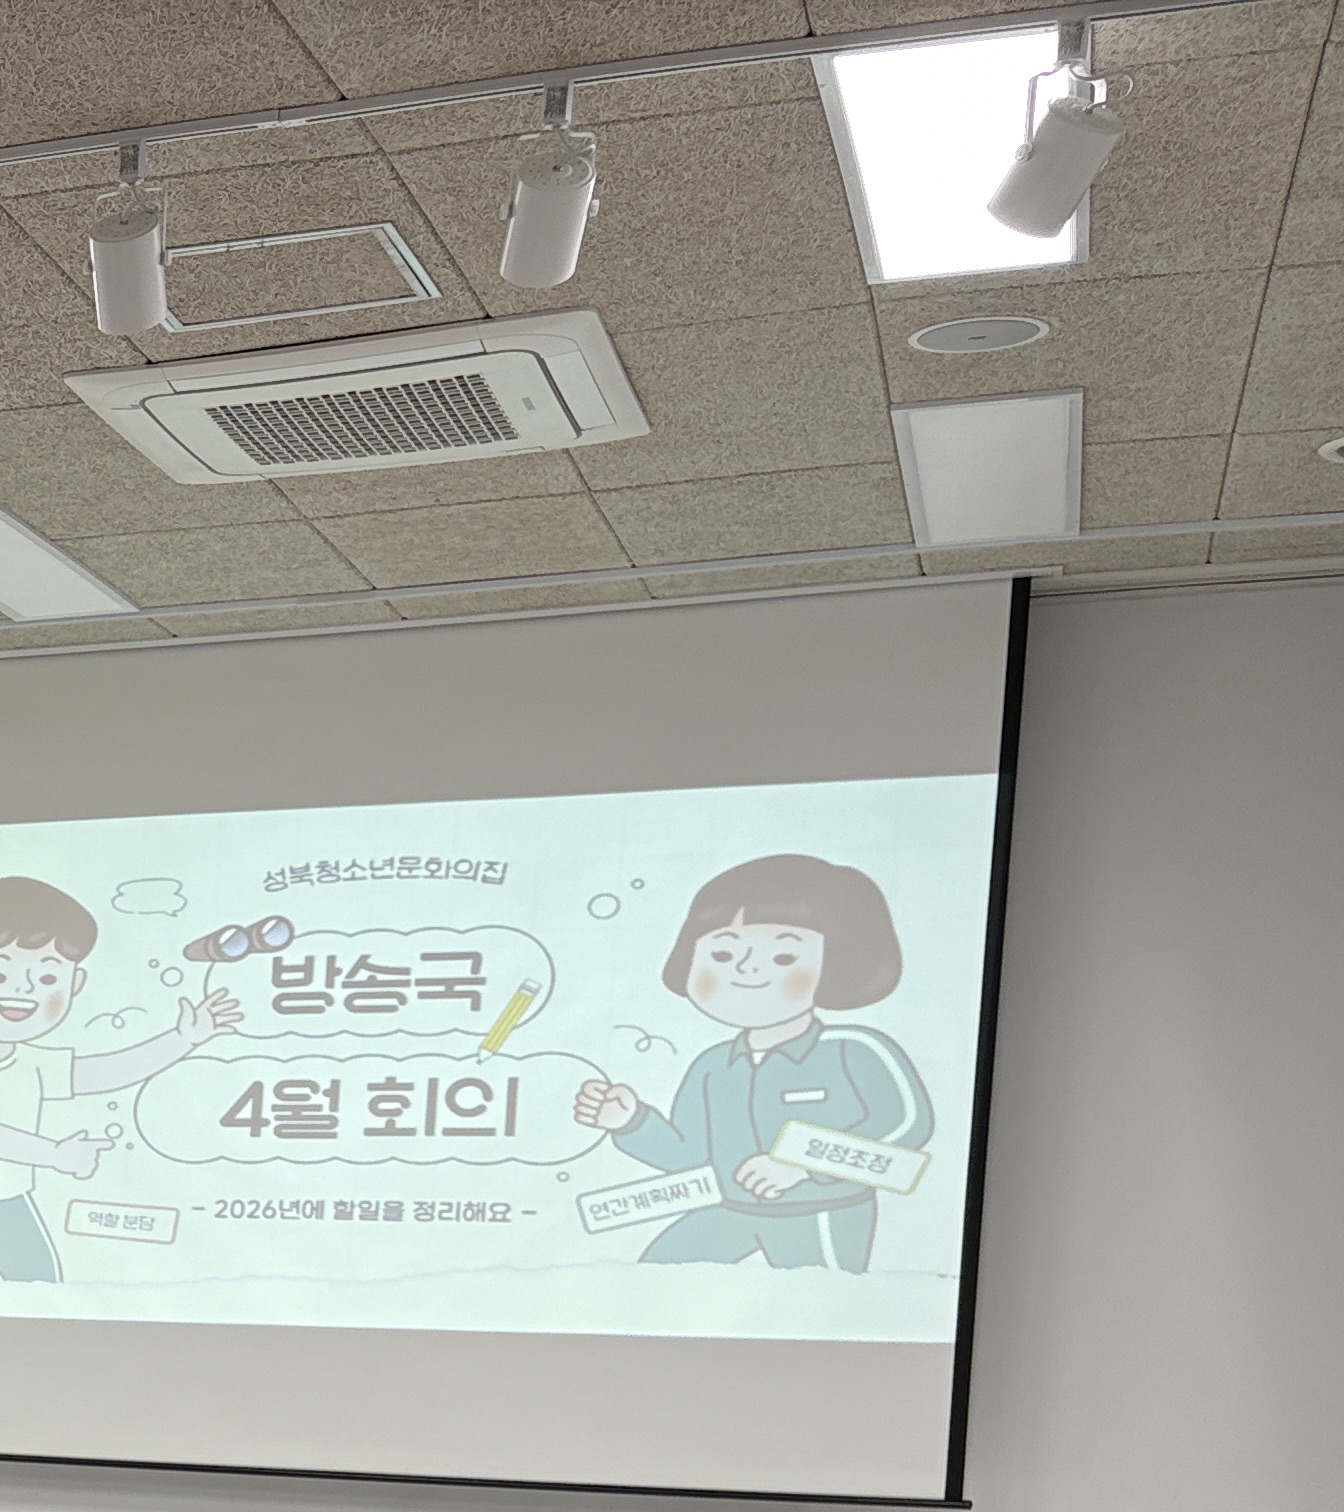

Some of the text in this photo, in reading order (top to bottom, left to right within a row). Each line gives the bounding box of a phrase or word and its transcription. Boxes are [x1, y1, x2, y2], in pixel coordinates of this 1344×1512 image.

[263, 856, 509, 892] 성북청소년문화의집
[271, 951, 487, 1015] 방송국
[219, 1076, 519, 1139] 4월 회의
[804, 1138, 893, 1175] 일정조정
[214, 1199, 325, 1220] 2026년에
[333, 1200, 404, 1221] 할일을
[413, 1201, 512, 1223] 정리해요
